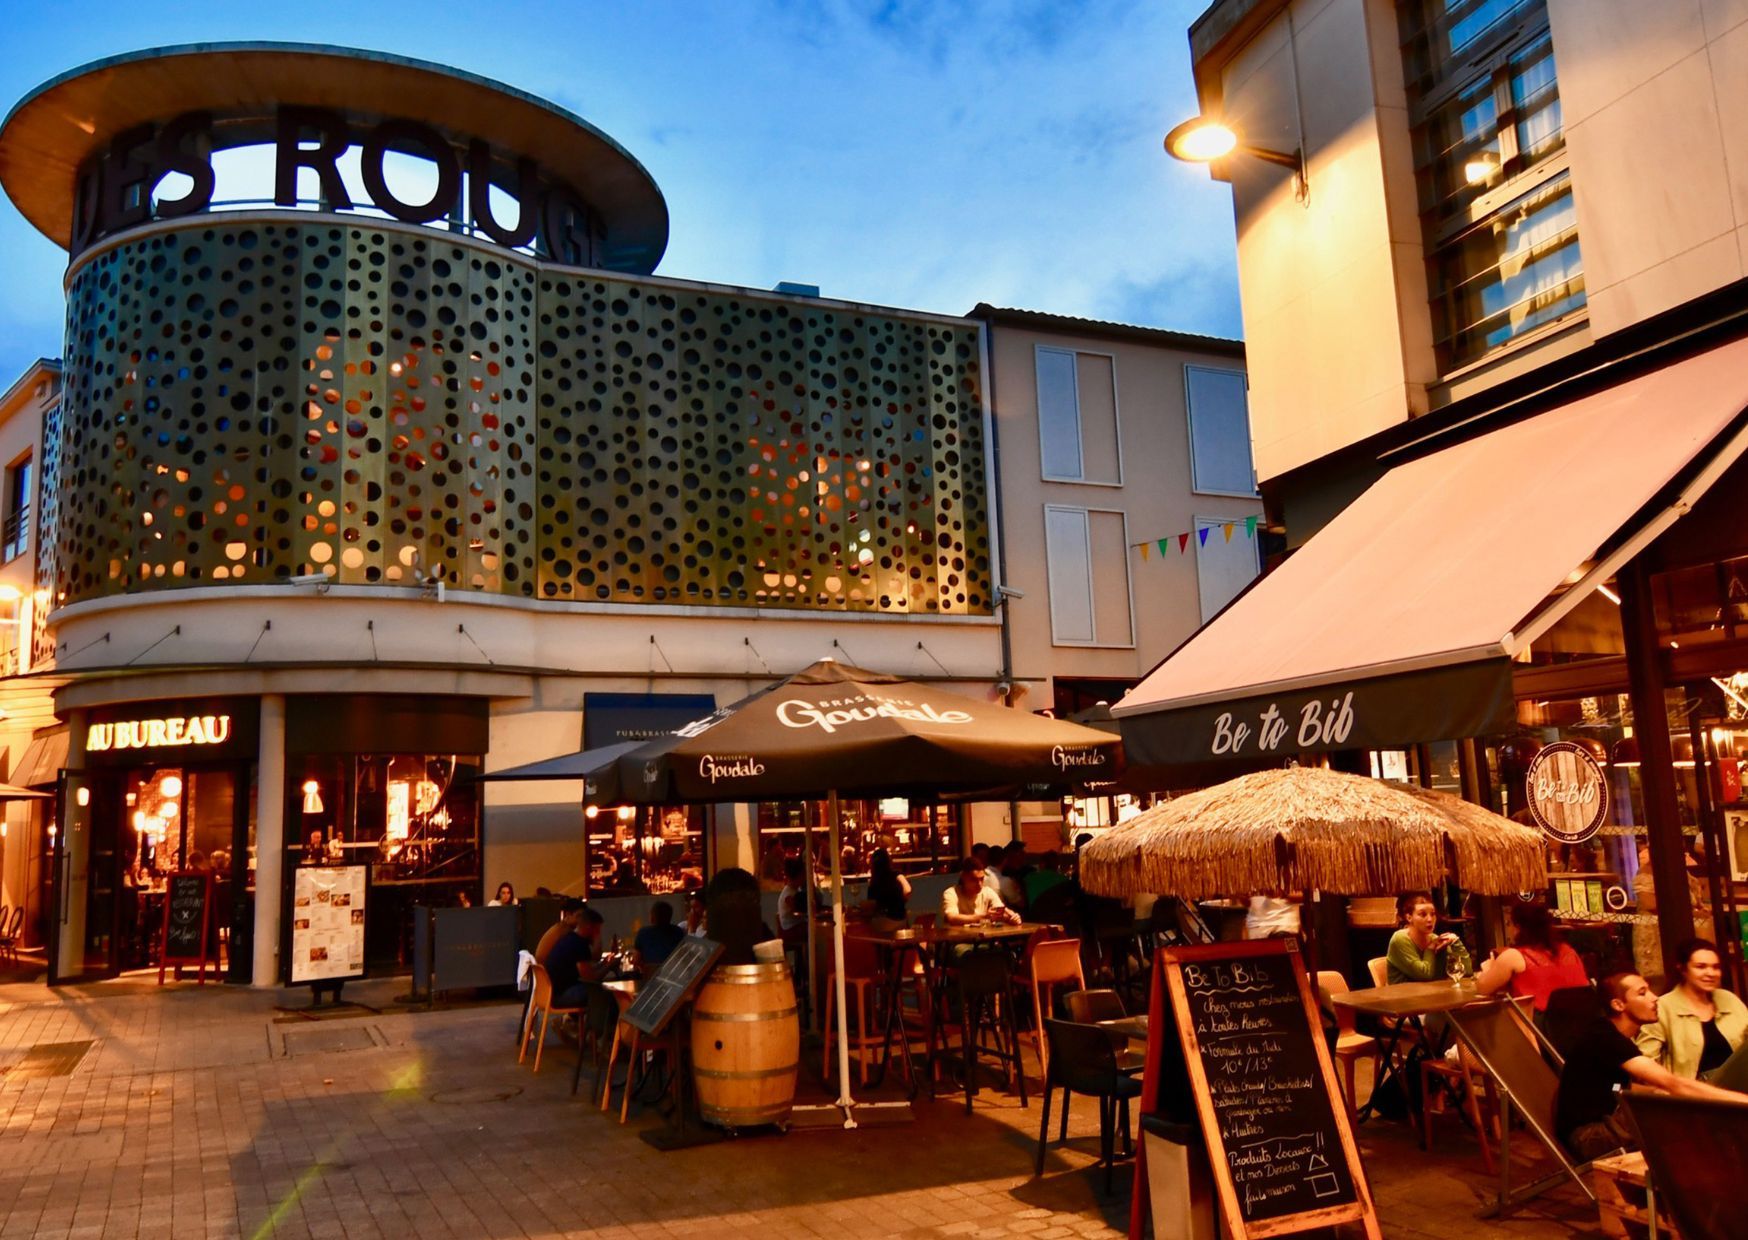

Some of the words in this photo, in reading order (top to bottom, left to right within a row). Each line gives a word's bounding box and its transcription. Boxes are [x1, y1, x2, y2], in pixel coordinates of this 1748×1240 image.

[776, 699, 973, 733] Goudale
[1212, 712, 1251, 754] Be
[1259, 704, 1289, 750] to
[1298, 691, 1354, 747] Bib
[86, 723, 113, 751] AU
[114, 715, 230, 749] BUREAU
[700, 754, 765, 784] Goudale
[1052, 745, 1106, 772] Goudale
[1185, 964, 1211, 988] Be
[1231, 963, 1269, 985] Bib
[1242, 1013, 1272, 1029] heures
[1246, 1042, 1260, 1055] du
[1228, 1147, 1272, 1167] Produits
